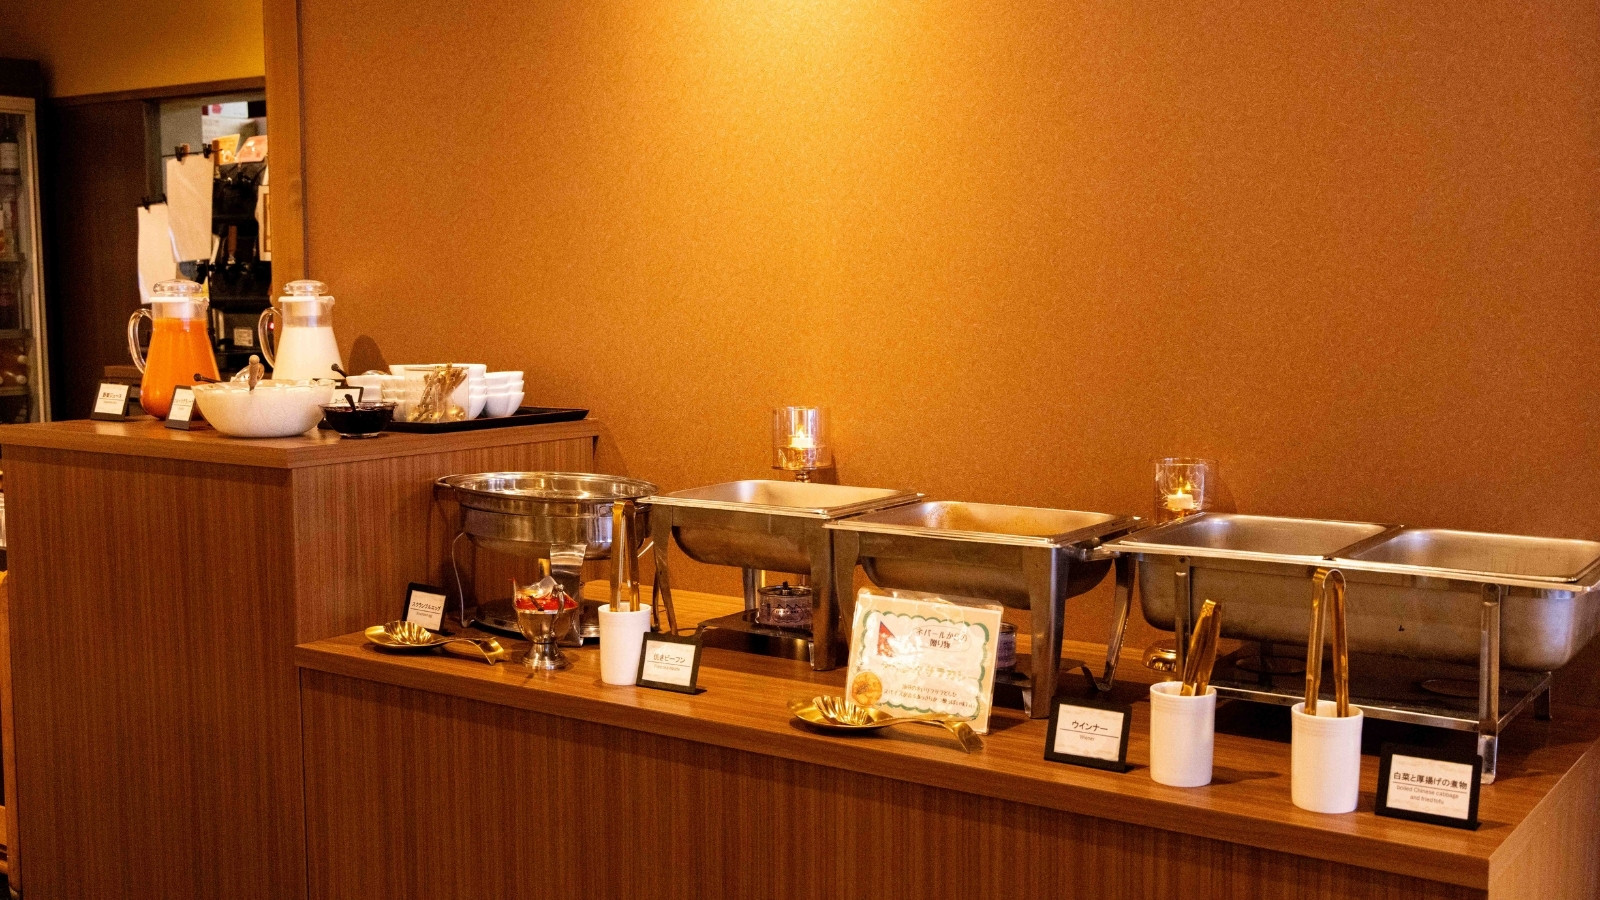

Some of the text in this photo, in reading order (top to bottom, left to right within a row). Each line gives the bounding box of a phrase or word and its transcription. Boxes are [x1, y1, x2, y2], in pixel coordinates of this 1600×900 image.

[411, 601, 442, 612] スクランブルエッグ
[929, 638, 951, 649] 贈り物
[1071, 720, 1109, 732] ウインナー
[1393, 771, 1468, 790] 白菜と厚揚げの煮物
[1413, 787, 1435, 795] Chinese
